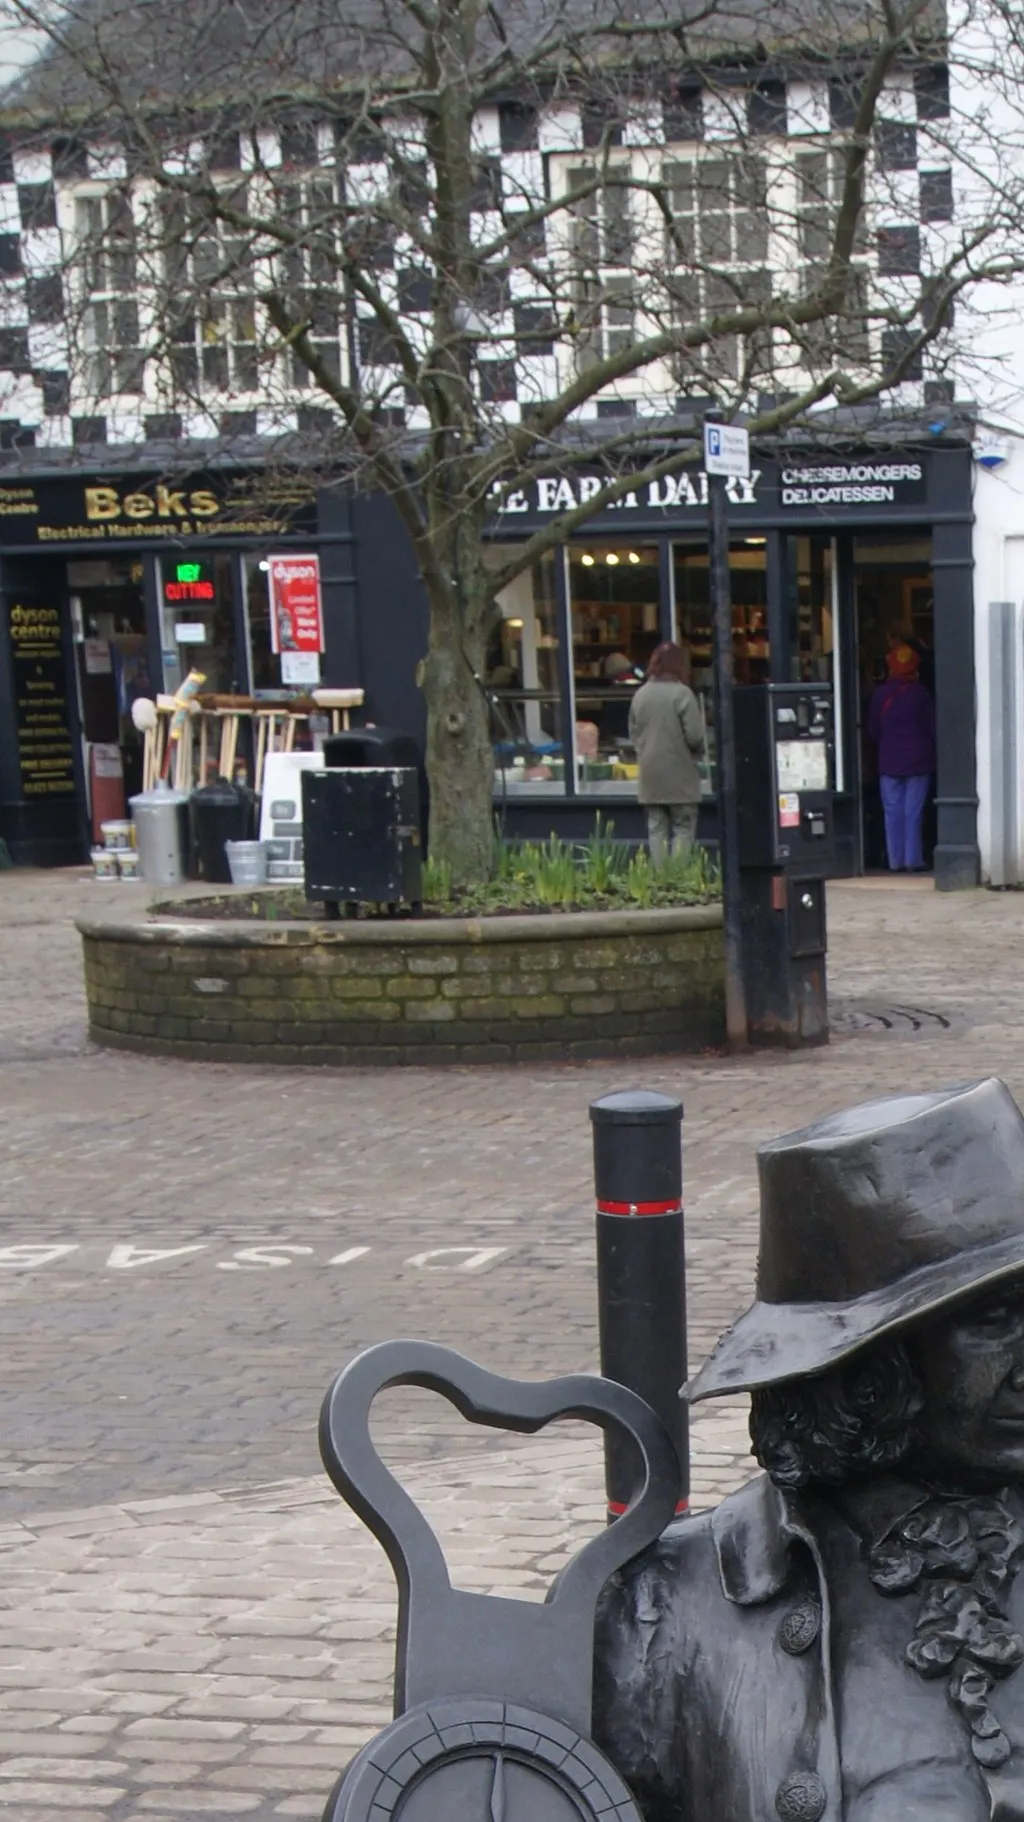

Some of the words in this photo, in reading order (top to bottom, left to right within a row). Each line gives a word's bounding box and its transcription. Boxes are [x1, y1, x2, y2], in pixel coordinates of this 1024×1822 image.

[85, 485, 221, 520] Beks
[782, 486, 894, 504] DELICATESSEN
[38, 526, 105, 541] Electrical
[107, 523, 178, 538] Hardware
[273, 563, 316, 584] dyson
[166, 582, 214, 599] CUTTING
[11, 604, 58, 625] dyson
[10, 624, 61, 640] centre
